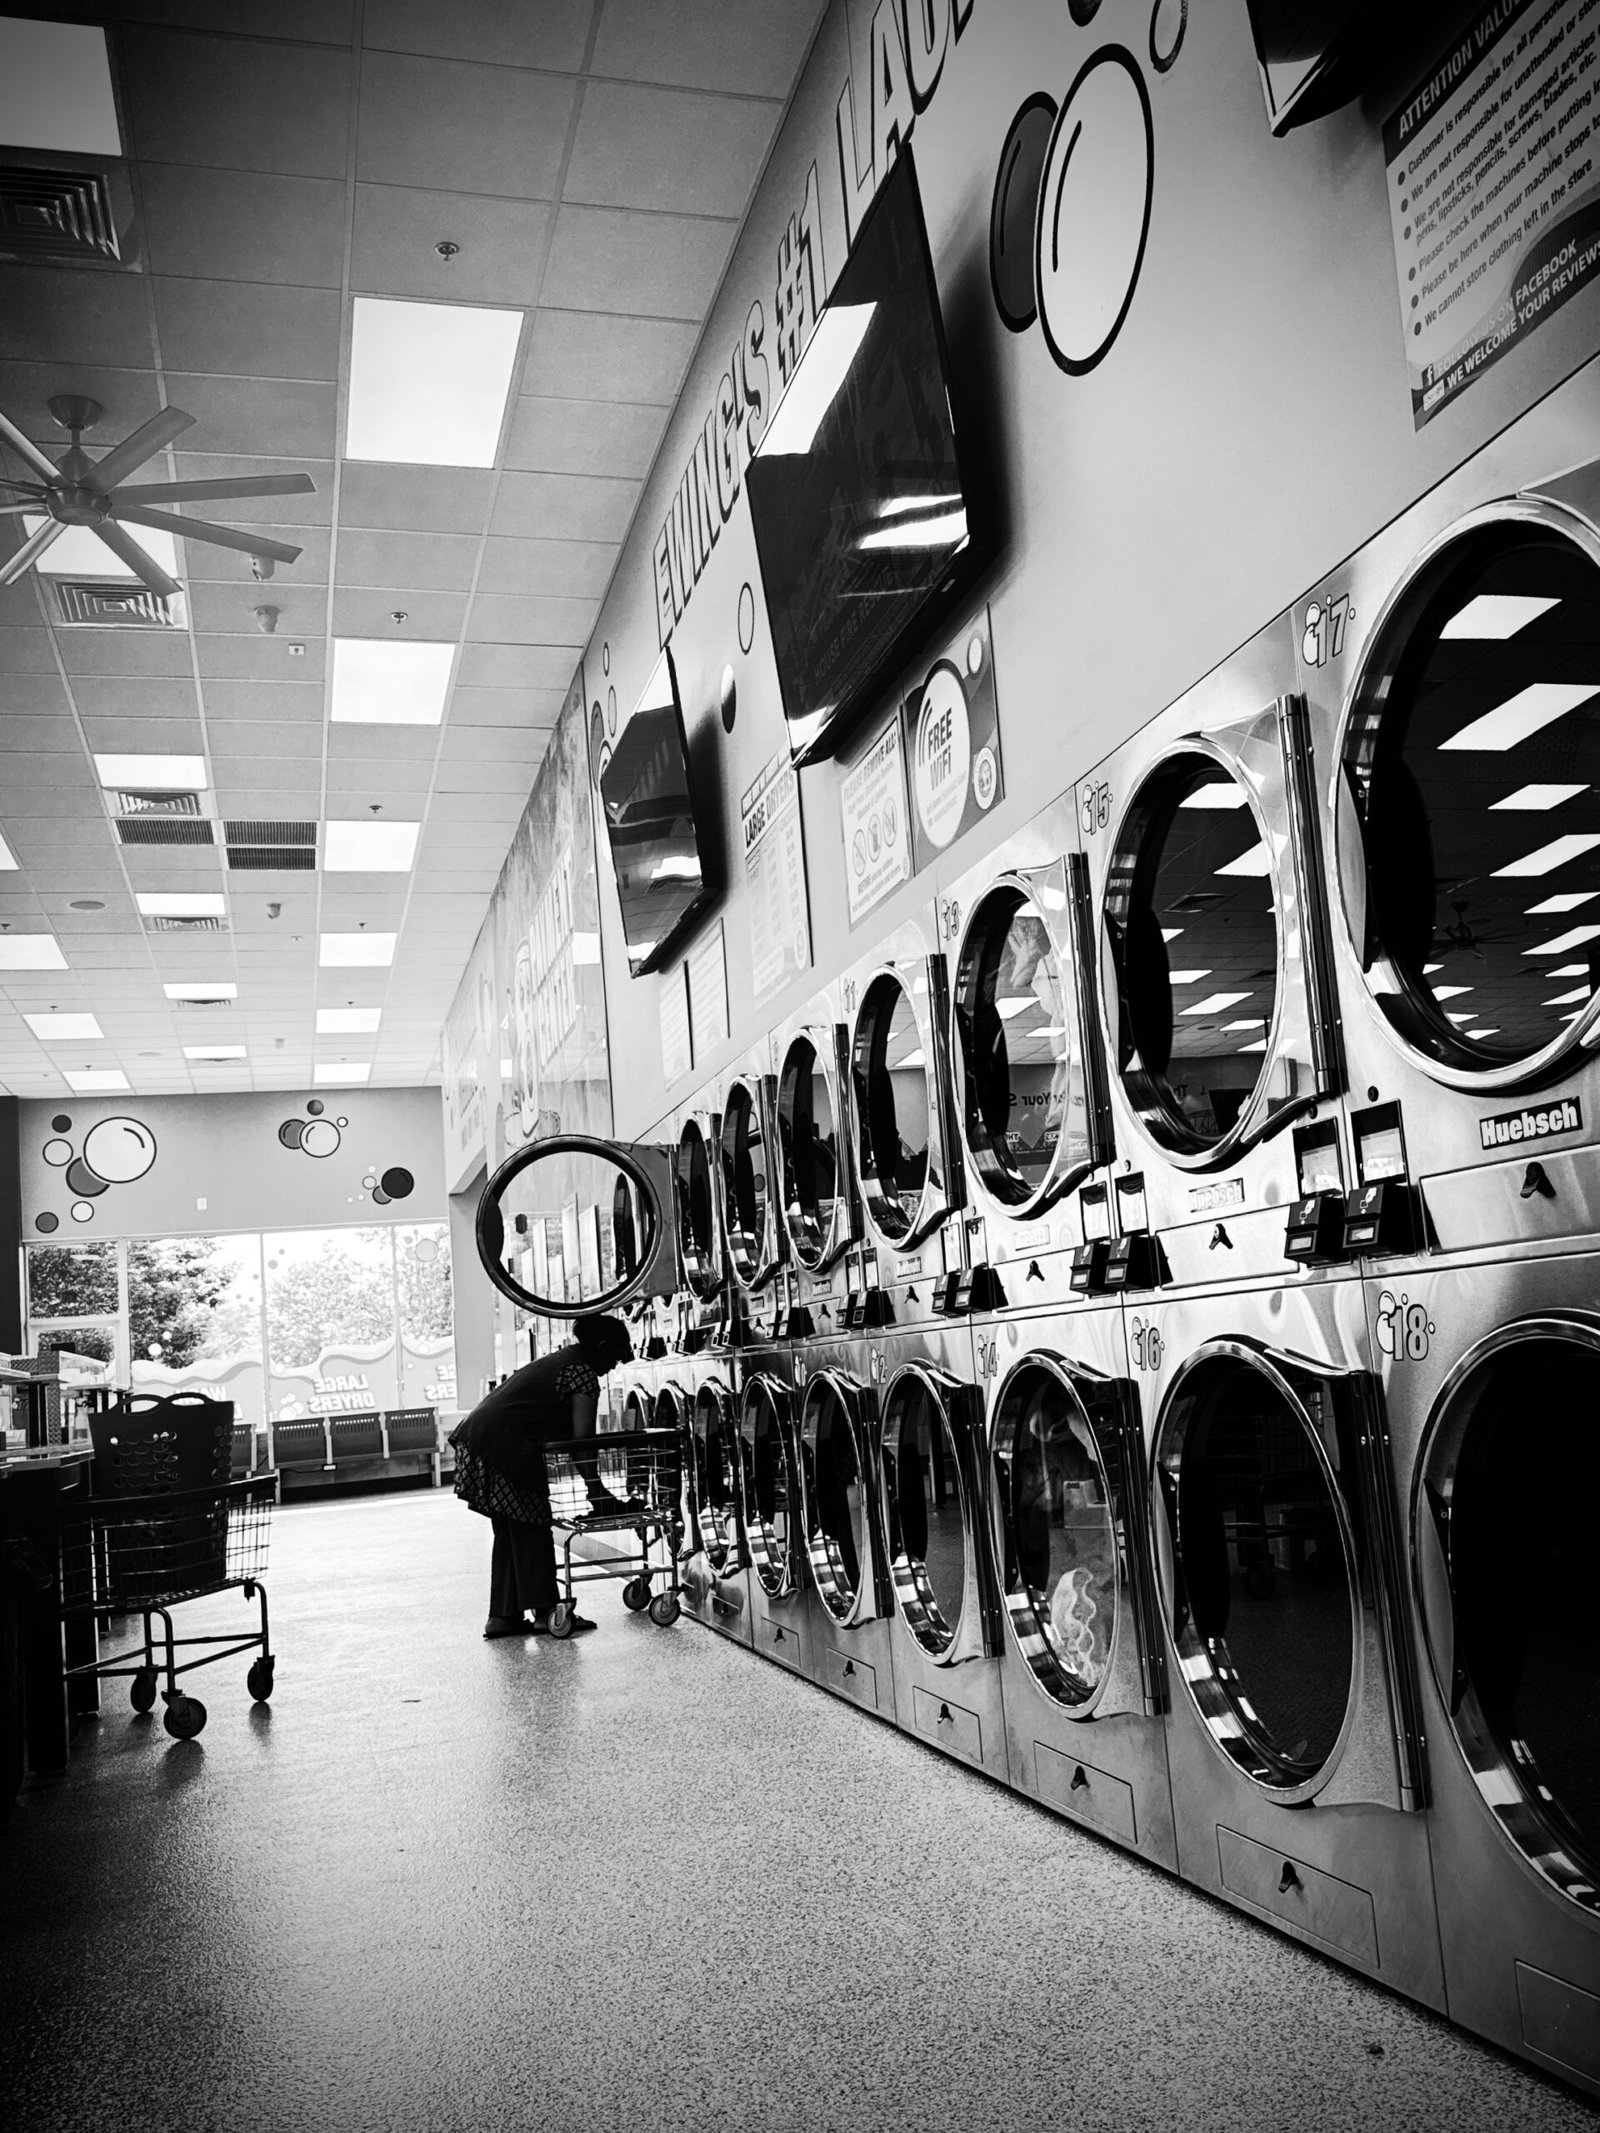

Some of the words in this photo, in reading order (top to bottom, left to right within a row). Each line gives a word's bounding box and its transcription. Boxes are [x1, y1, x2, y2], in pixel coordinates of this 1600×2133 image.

[1399, 37, 1473, 141] ATTENTION
[1474, 0, 1519, 48] VALU
[1408, 129, 1444, 174] Customer
[1445, 120, 1453, 134] is
[1455, 67, 1501, 124] responsible
[1502, 50, 1514, 71] for
[1516, 33, 1527, 55] all
[1411, 184, 1423, 201] We
[1425, 169, 1437, 188] are
[1439, 151, 1452, 173] not
[1453, 101, 1499, 158] responsible
[1501, 86, 1513, 106] for
[1515, 26, 1564, 90] unattended
[1566, 15, 1576, 34] or
[1414, 211, 1426, 229] We
[1428, 197, 1440, 216] are
[1442, 179, 1455, 201] not
[1456, 131, 1502, 186] responsible
[1504, 115, 1516, 134] for
[1518, 66, 1559, 119] damaged
[1561, 31, 1596, 75] articles
[776, 159, 827, 388] #1
[836, 0, 976, 258] LAU
[1416, 220, 1437, 248] pens,
[1438, 181, 1474, 222] lipsticks,
[1475, 146, 1507, 187] pencils,
[1509, 109, 1542, 148] screws,
[1544, 73, 1577, 111] blades,
[1579, 52, 1597, 74] etc.
[1419, 241, 1444, 272] Please
[1446, 215, 1470, 245] check
[1471, 201, 1484, 219] the
[1485, 157, 1526, 205] machines
[1528, 126, 1556, 161] before
[1558, 90, 1591, 134] putting
[1422, 269, 1447, 299] Please
[1449, 258, 1458, 274] be
[1460, 238, 1478, 262] here
[1479, 214, 1502, 242] when
[1504, 192, 1522, 221] your
[1524, 153, 1562, 198] machine
[1564, 125, 1590, 158] stops
[1425, 310, 1437, 327] We
[1438, 280, 1465, 314] cannot
[1466, 261, 1487, 288] store
[1489, 227, 1522, 266] clothing
[1523, 208, 1538, 232] left
[1540, 200, 1549, 216] in
[1551, 184, 1566, 206] the
[1568, 159, 1592, 189] store
[1438, 329, 1480, 375] FOLLOW
[1482, 317, 1495, 337] US
[1497, 297, 1514, 321] ON
[1515, 239, 1577, 306] FACEBOOK
[1446, 364, 1464, 389] WE
[1464, 317, 1518, 374] WELCOME
[1518, 287, 1550, 325] YOUR
[1313, 593, 1350, 668] 17
[927, 706, 952, 761] FREE
[744, 802, 766, 849] LARGE
[766, 763, 794, 821] DRYERS
[1087, 782, 1111, 836] 15
[943, 900, 960, 942] 13
[1481, 1102, 1578, 1147] Huebsch
[981, 1341, 998, 1379] 14
[1137, 1326, 1162, 1371] 16
[1388, 1303, 1429, 1361] 18
